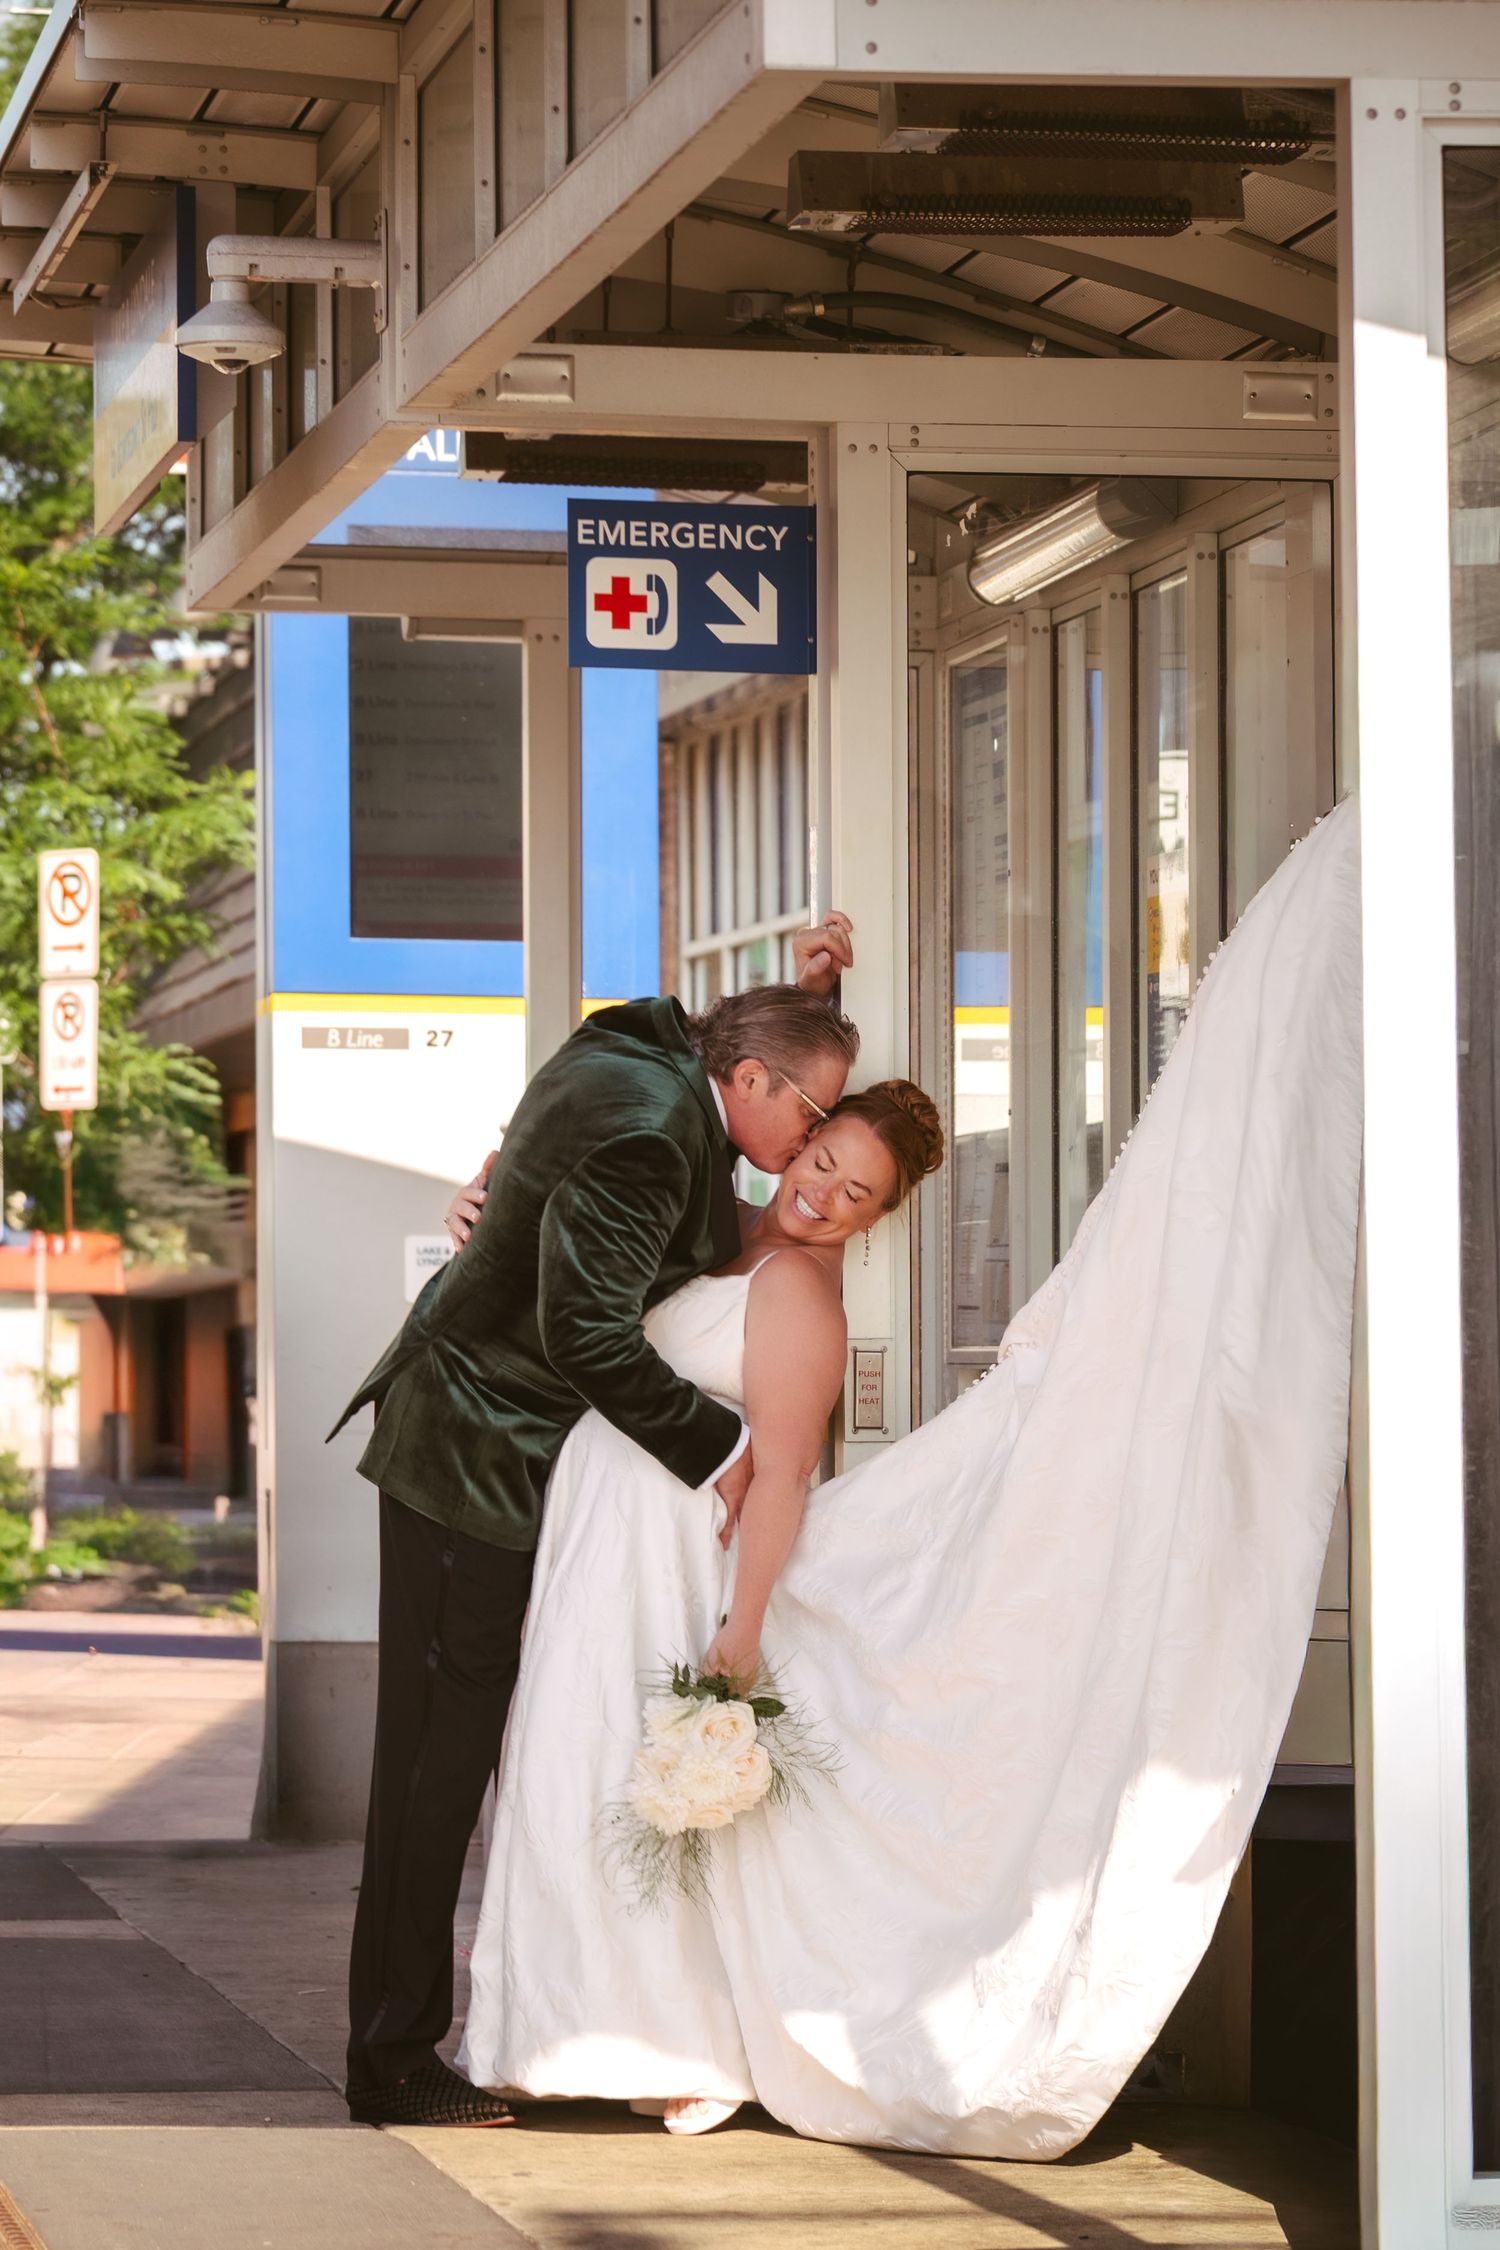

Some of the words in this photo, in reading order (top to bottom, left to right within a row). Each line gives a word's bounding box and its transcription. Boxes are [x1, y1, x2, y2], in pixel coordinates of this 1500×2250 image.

[577, 519, 788, 551] EMERGENCY
[327, 1028, 341, 1047] B
[346, 1029, 385, 1048] Line
[426, 1030, 454, 1047] 27
[858, 1370, 881, 1378] PUSH
[858, 1397, 881, 1405] HEAT
